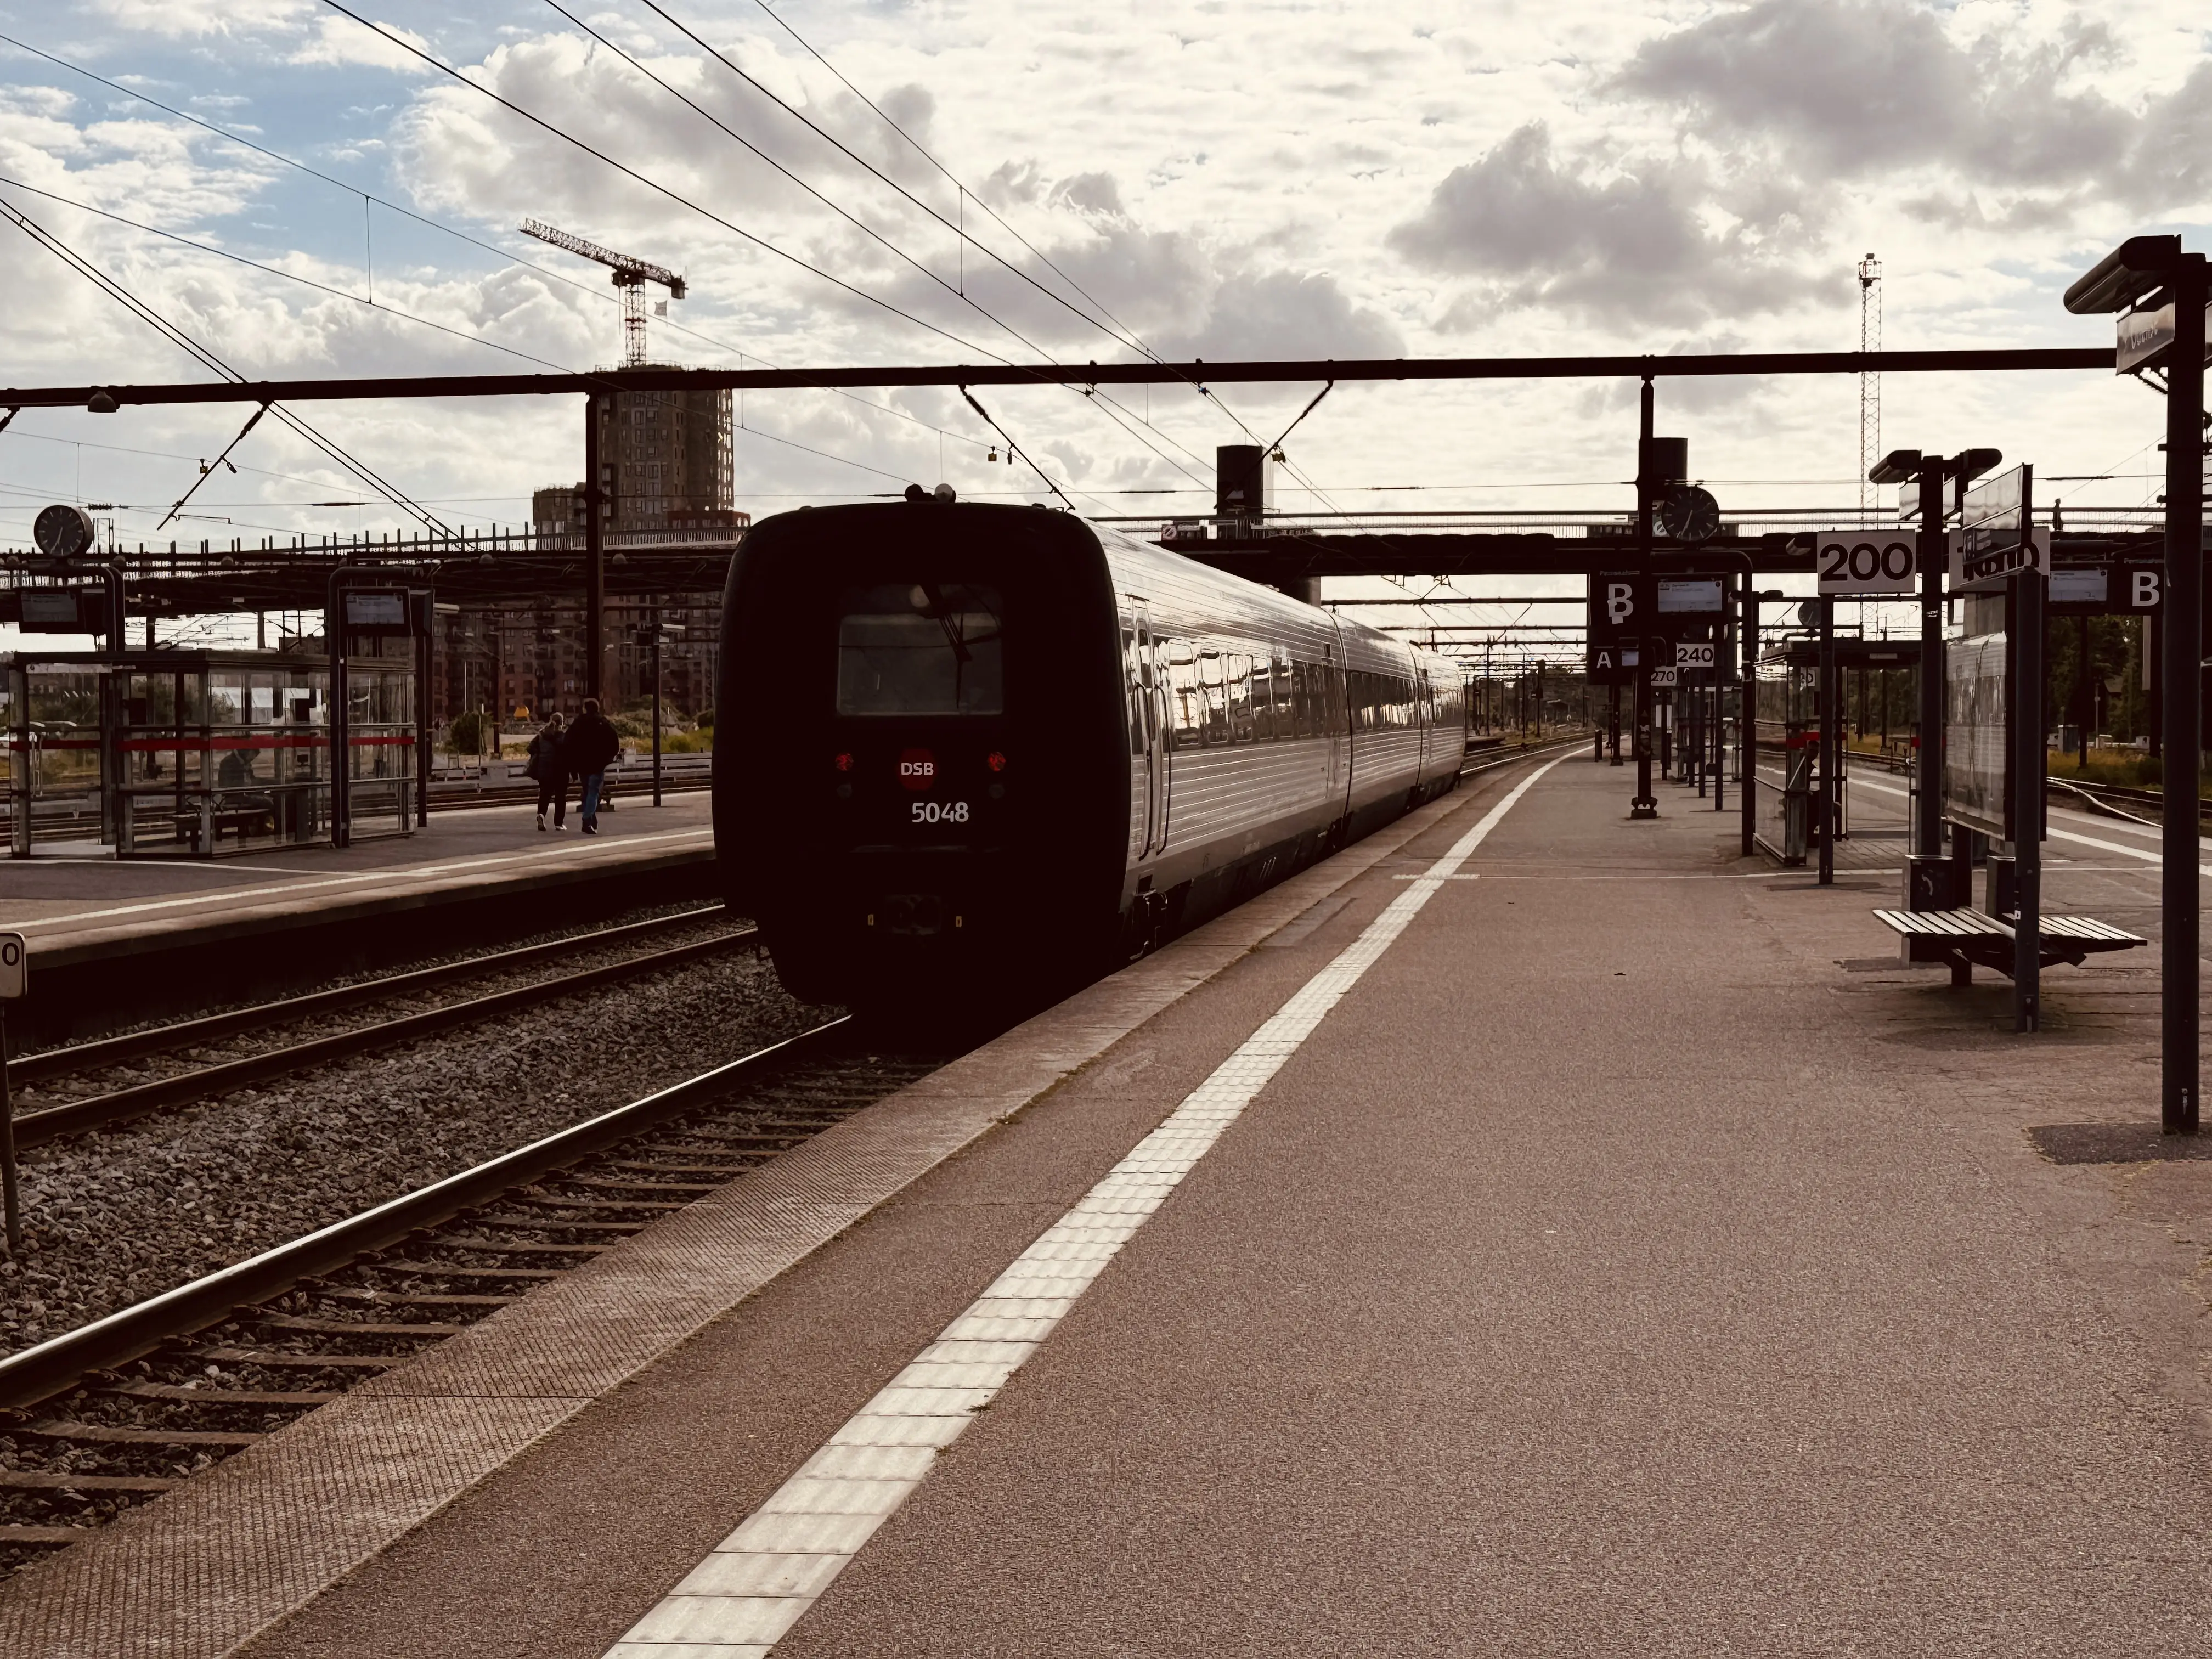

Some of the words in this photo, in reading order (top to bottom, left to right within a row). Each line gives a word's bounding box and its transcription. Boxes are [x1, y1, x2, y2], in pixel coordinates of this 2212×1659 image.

[1820, 542, 1913, 581] 200
[2132, 572, 2160, 606] B
[1608, 583, 1634, 617] B
[1596, 652, 1612, 669] A
[1677, 647, 1713, 662] 240
[1651, 671, 1675, 681] 270
[901, 762, 934, 776] DSB
[912, 802, 969, 823] 5048
